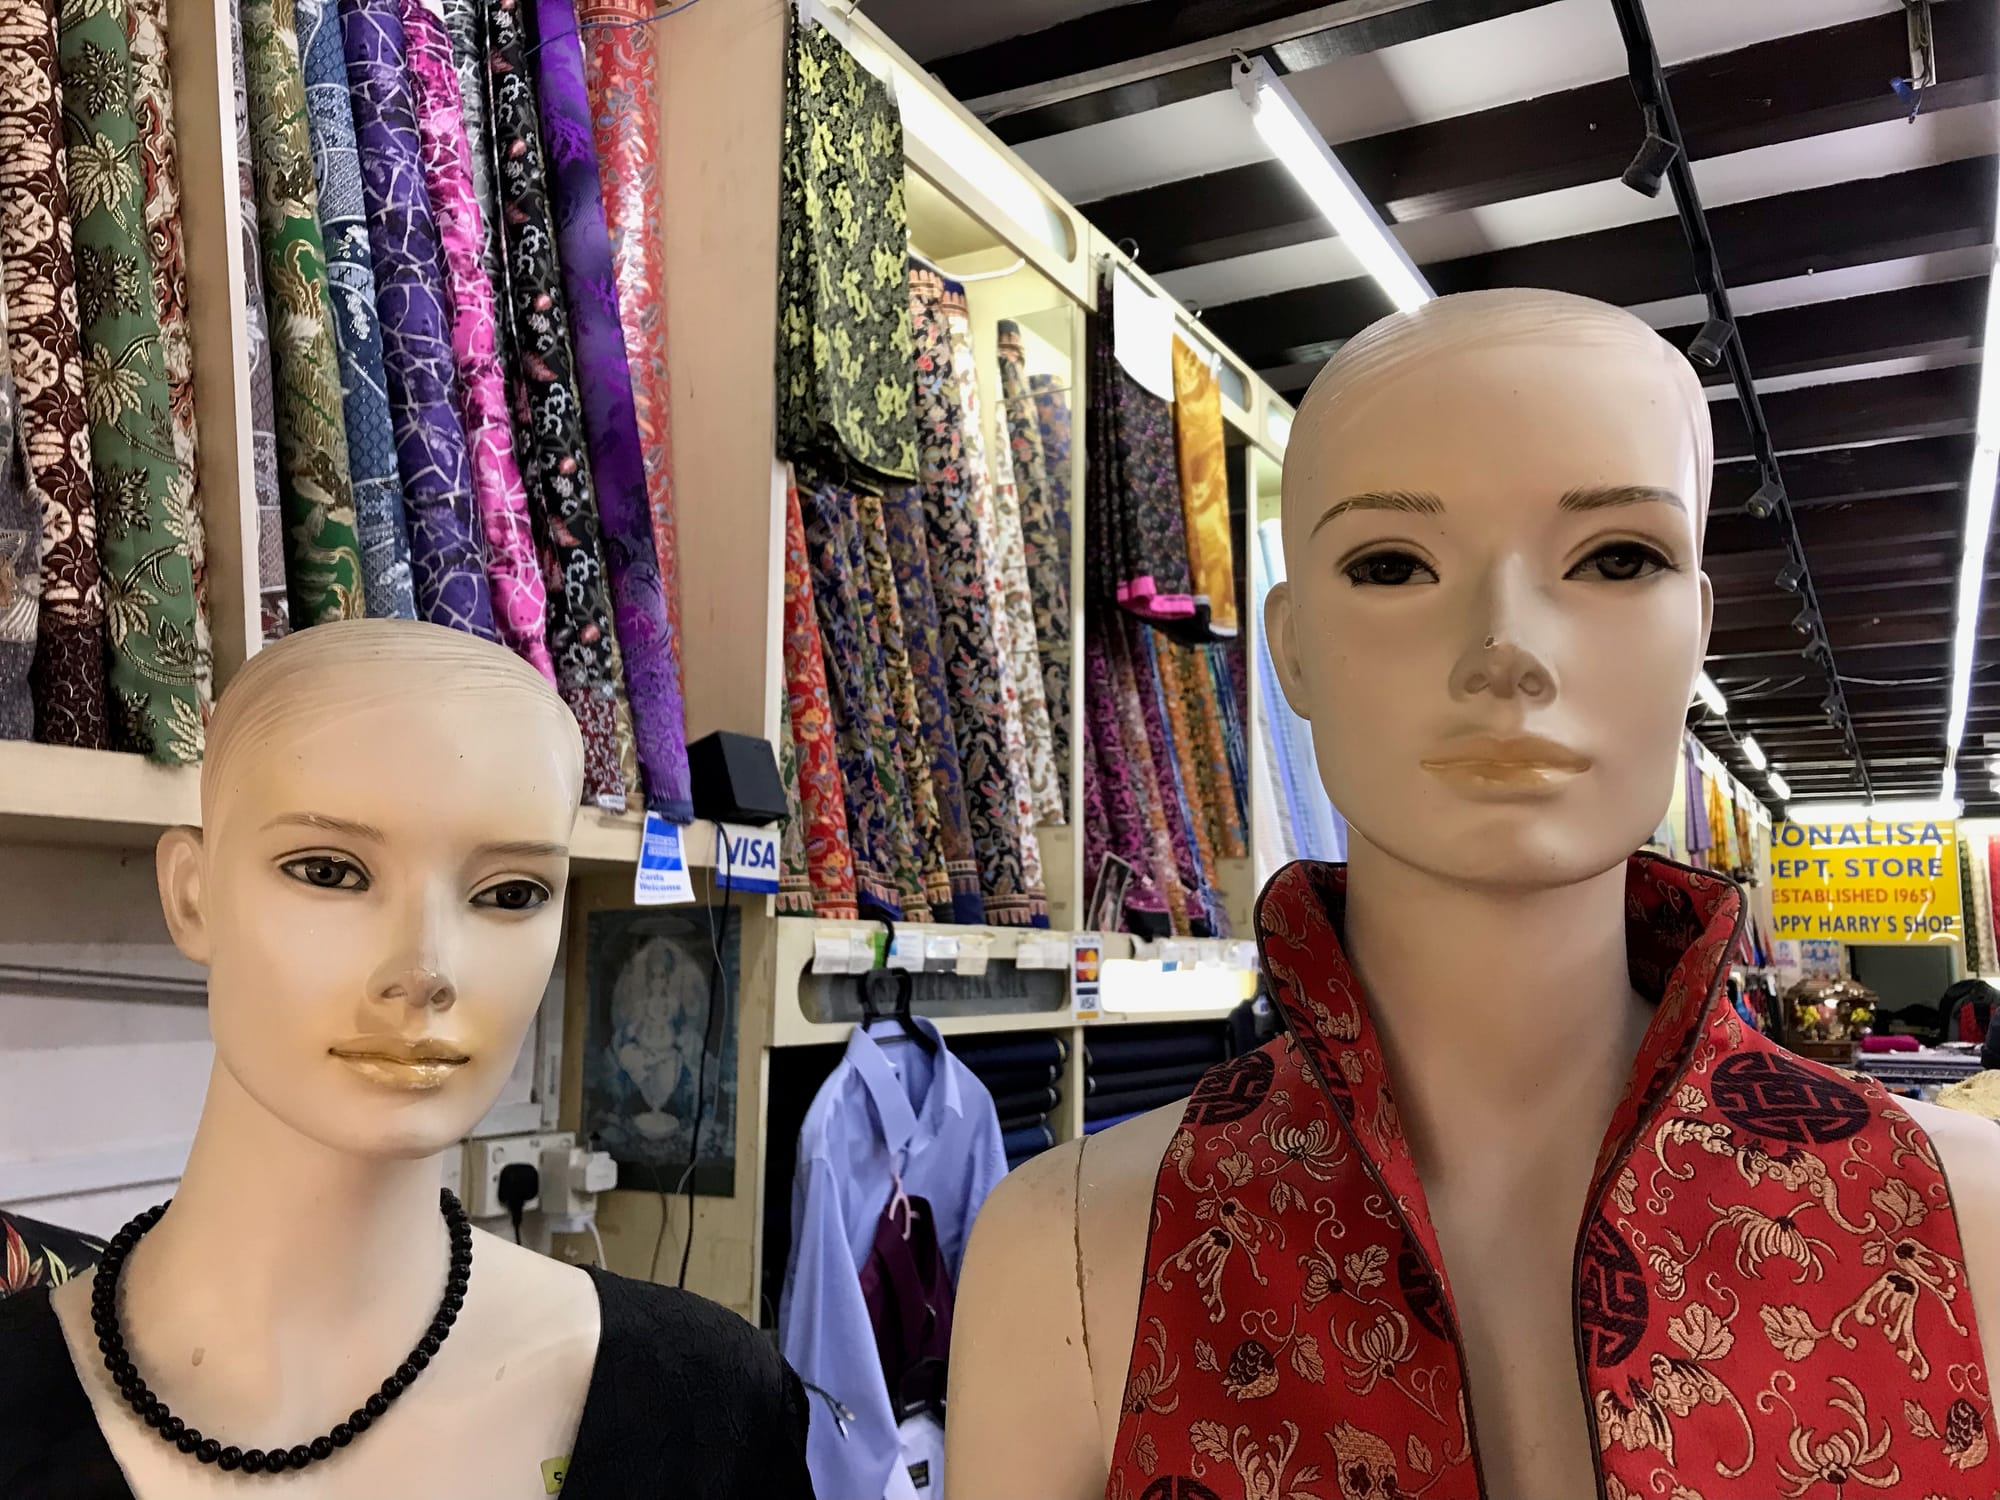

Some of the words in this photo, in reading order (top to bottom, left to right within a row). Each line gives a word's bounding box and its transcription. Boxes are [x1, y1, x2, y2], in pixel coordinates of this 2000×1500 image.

[728, 835, 776, 870] VISA
[1844, 857, 1943, 878] STORE
[639, 882, 682, 892] Welcome
[1894, 887, 1936, 904] 1965)
[1818, 914, 1897, 933] HARRY'S
[1903, 914, 1954, 933] SHOP
